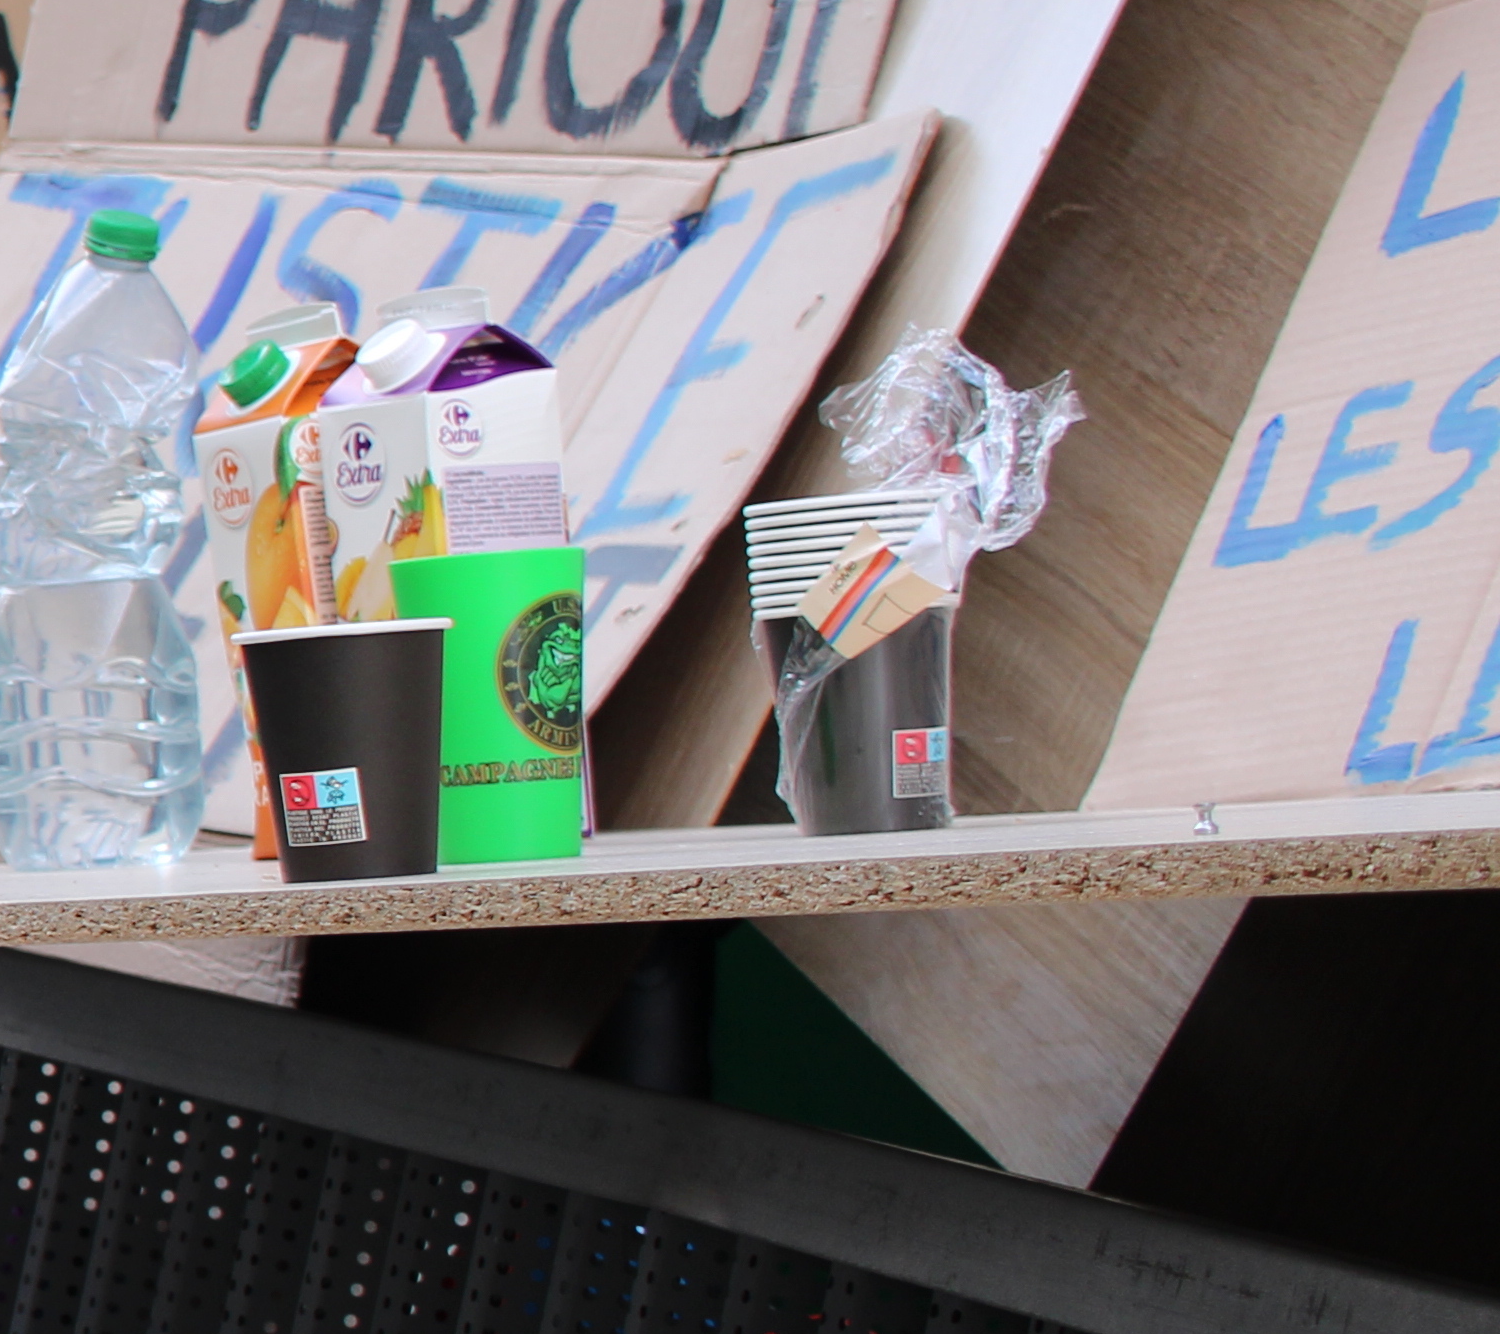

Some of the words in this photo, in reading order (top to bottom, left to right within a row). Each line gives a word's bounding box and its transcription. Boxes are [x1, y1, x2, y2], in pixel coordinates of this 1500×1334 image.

[438, 424, 481, 447] Extra
[336, 462, 383, 490] Extra
[212, 484, 251, 513] Extra
